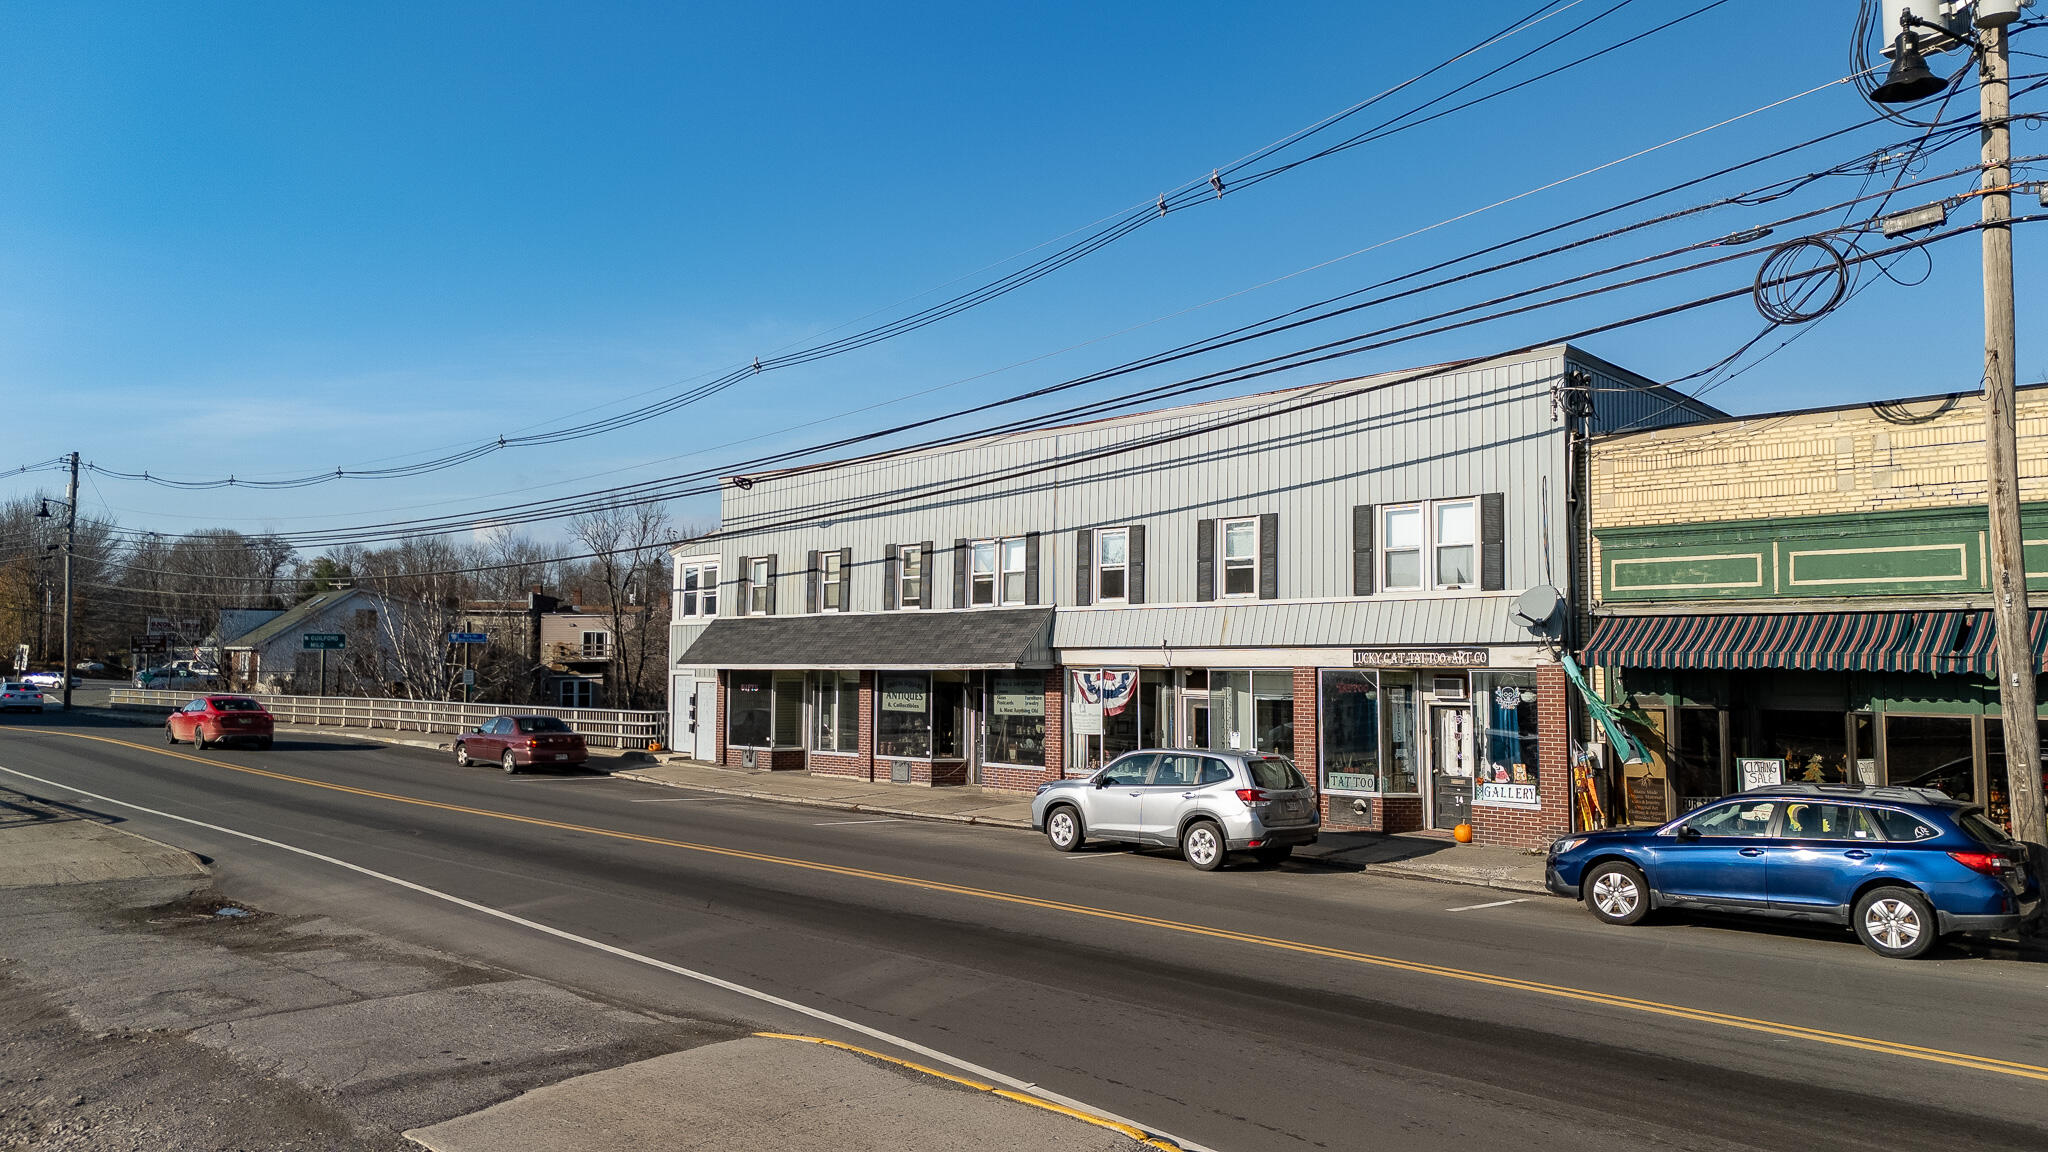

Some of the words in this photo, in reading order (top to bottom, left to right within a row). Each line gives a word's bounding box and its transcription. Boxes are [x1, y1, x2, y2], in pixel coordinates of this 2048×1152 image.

[1353, 652, 1381, 664] LUCKY
[1383, 652, 1405, 664] CAT
[1408, 652, 1446, 664] TATTOO
[1452, 650, 1472, 664] ART
[886, 691, 924, 702] ANTIQUES
[1330, 775, 1374, 788] TATTOO
[1748, 772, 1775, 784] SALE
[1484, 786, 1535, 801] GALLERY
